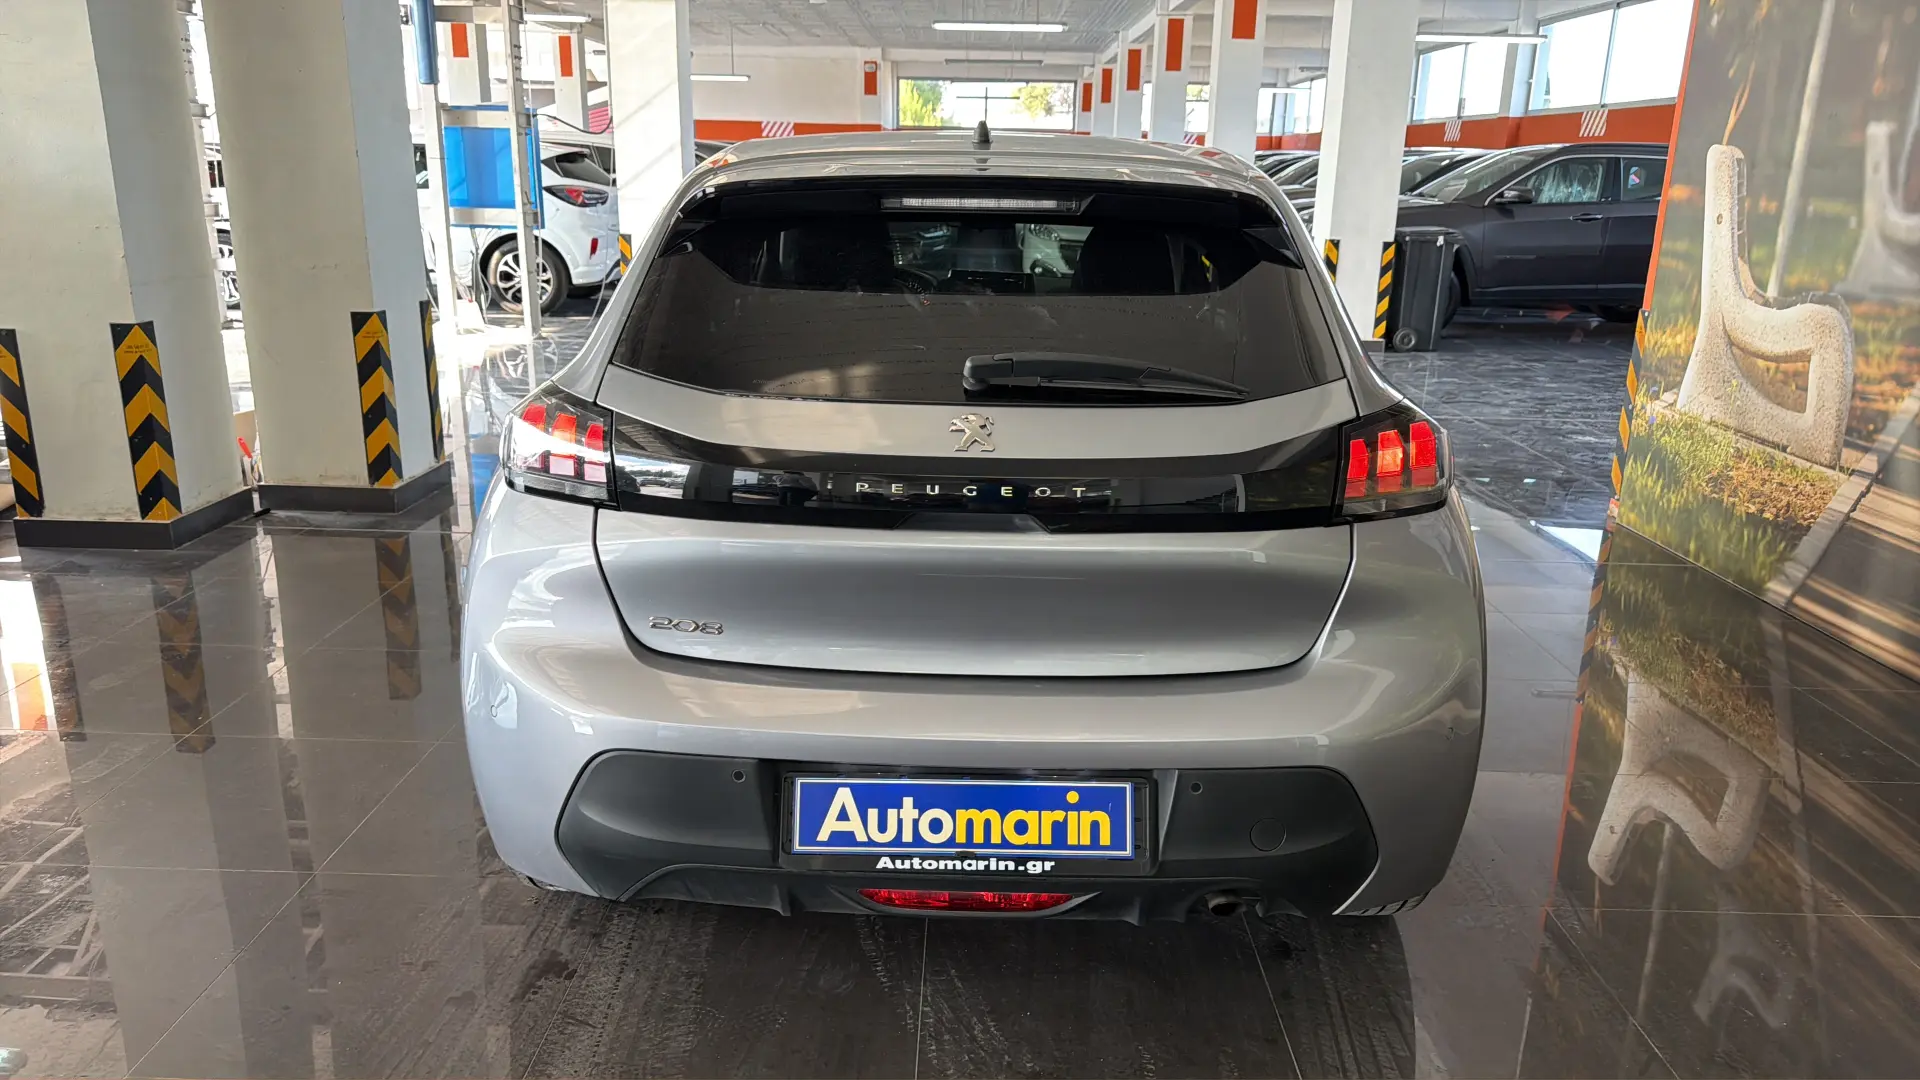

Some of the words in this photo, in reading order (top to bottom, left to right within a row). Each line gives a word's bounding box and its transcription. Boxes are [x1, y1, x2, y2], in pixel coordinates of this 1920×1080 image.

[855, 482, 1087, 498] PEUGEOT
[648, 616, 724, 635] 208
[815, 787, 1111, 846] Automarin
[875, 856, 1056, 874] Automarin.gr
